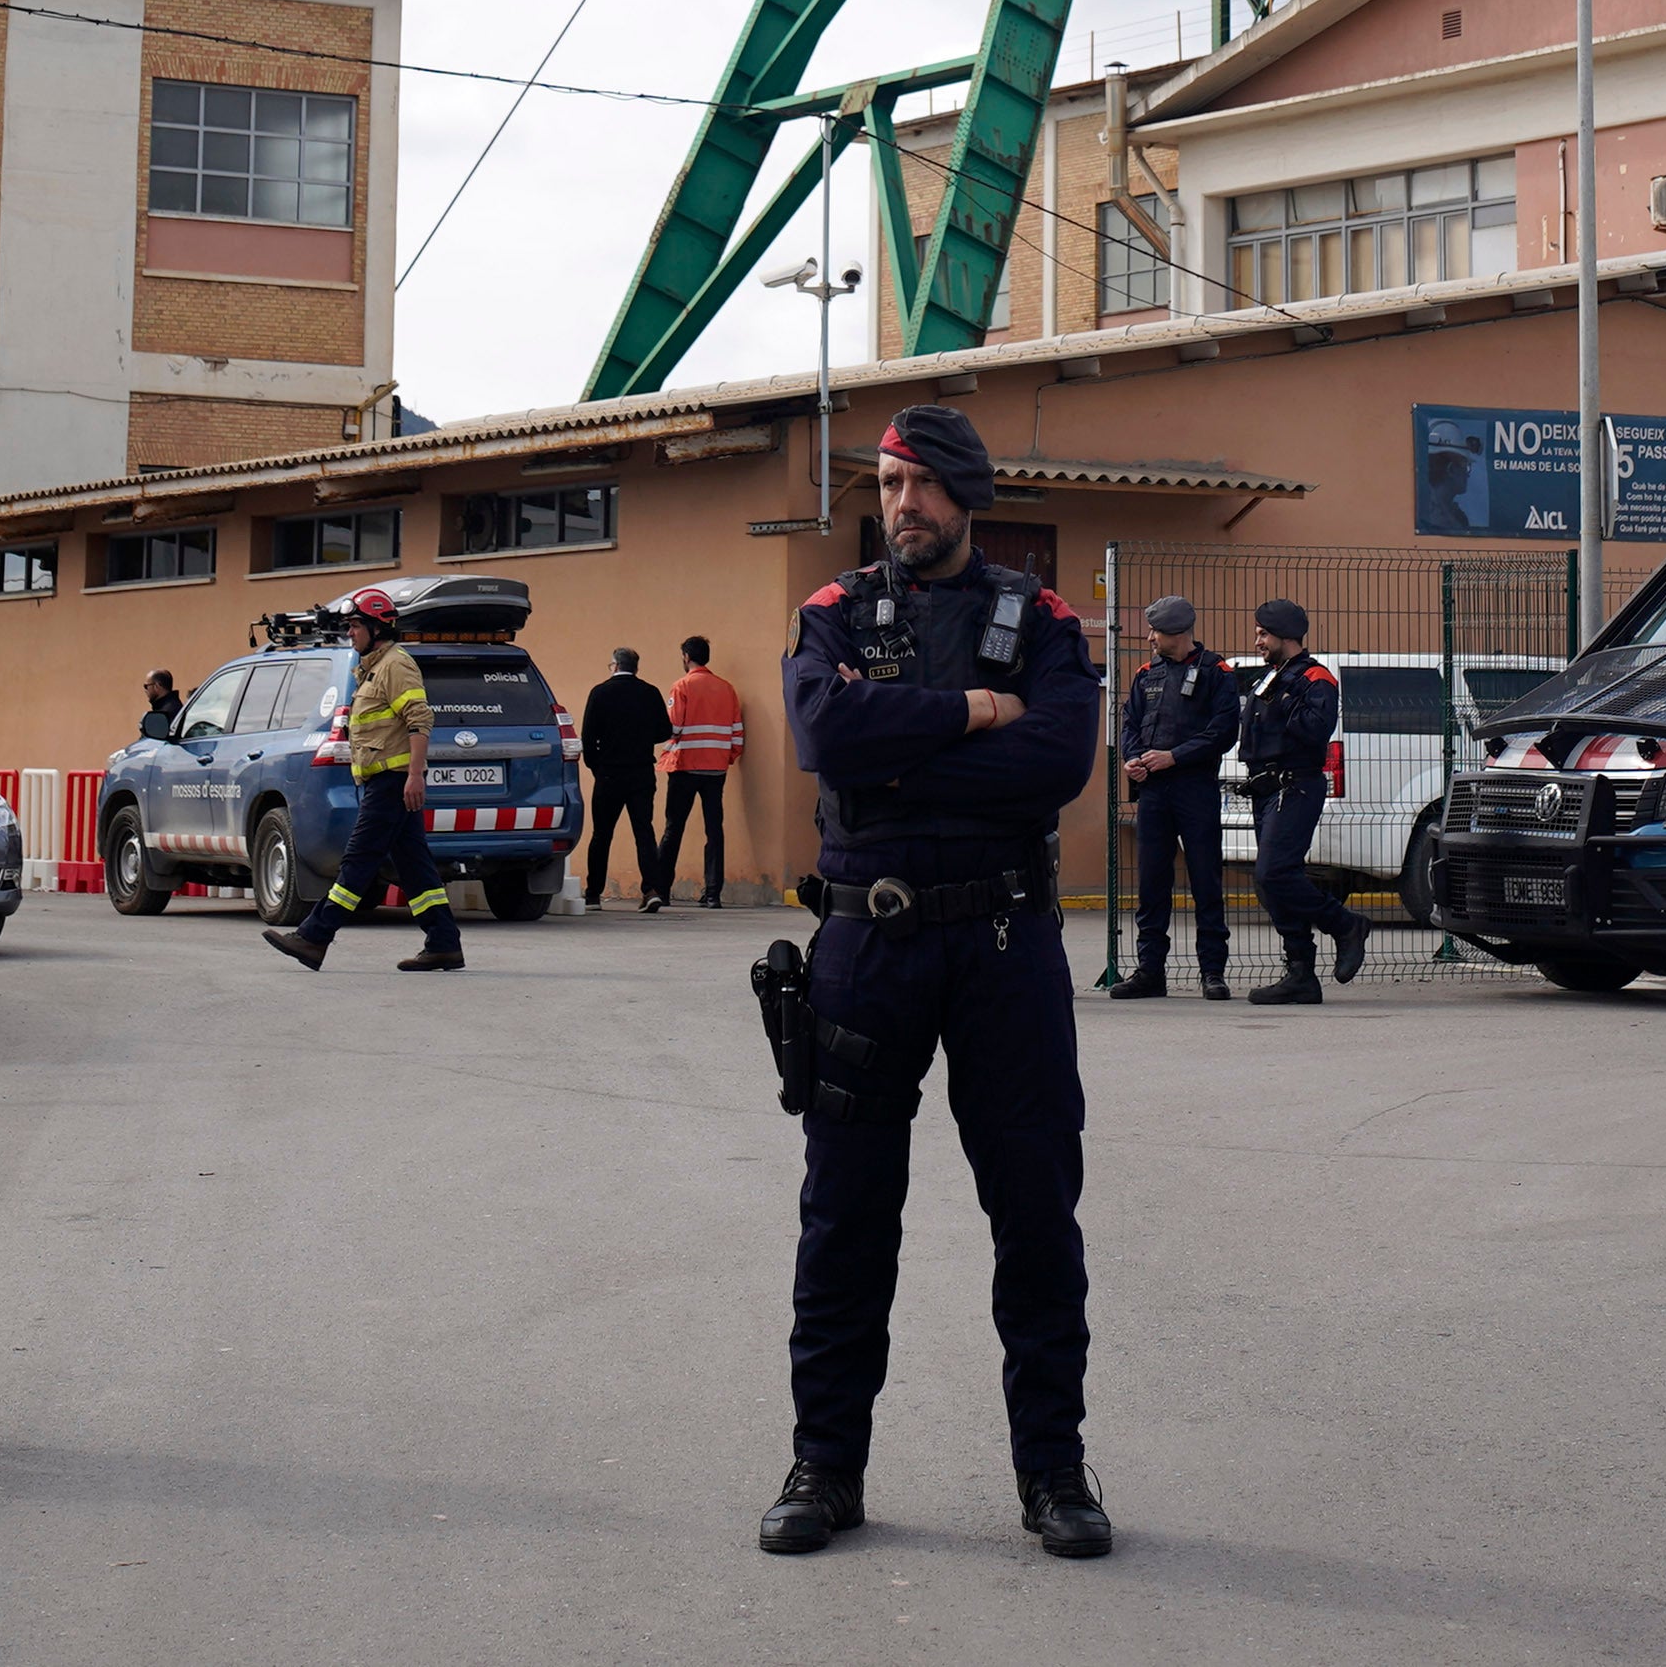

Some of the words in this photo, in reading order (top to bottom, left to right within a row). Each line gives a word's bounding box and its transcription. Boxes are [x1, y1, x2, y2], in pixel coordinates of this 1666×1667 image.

[1494, 421, 1542, 455] NO
[1616, 427, 1664, 441] SEGUEIX
[1542, 447, 1552, 455] LA
[1494, 460, 1507, 470] EN
[1509, 461, 1536, 471] MANS
[1539, 462, 1552, 472] DE
[1554, 462, 1566, 472] LA
[1568, 463, 1581, 473] SO
[1618, 444, 1635, 479] 5
[483, 672, 519, 683] policia
[430, 704, 503, 714] w.mossos.cat
[433, 769, 456, 783] CME
[464, 769, 495, 783] 0202
